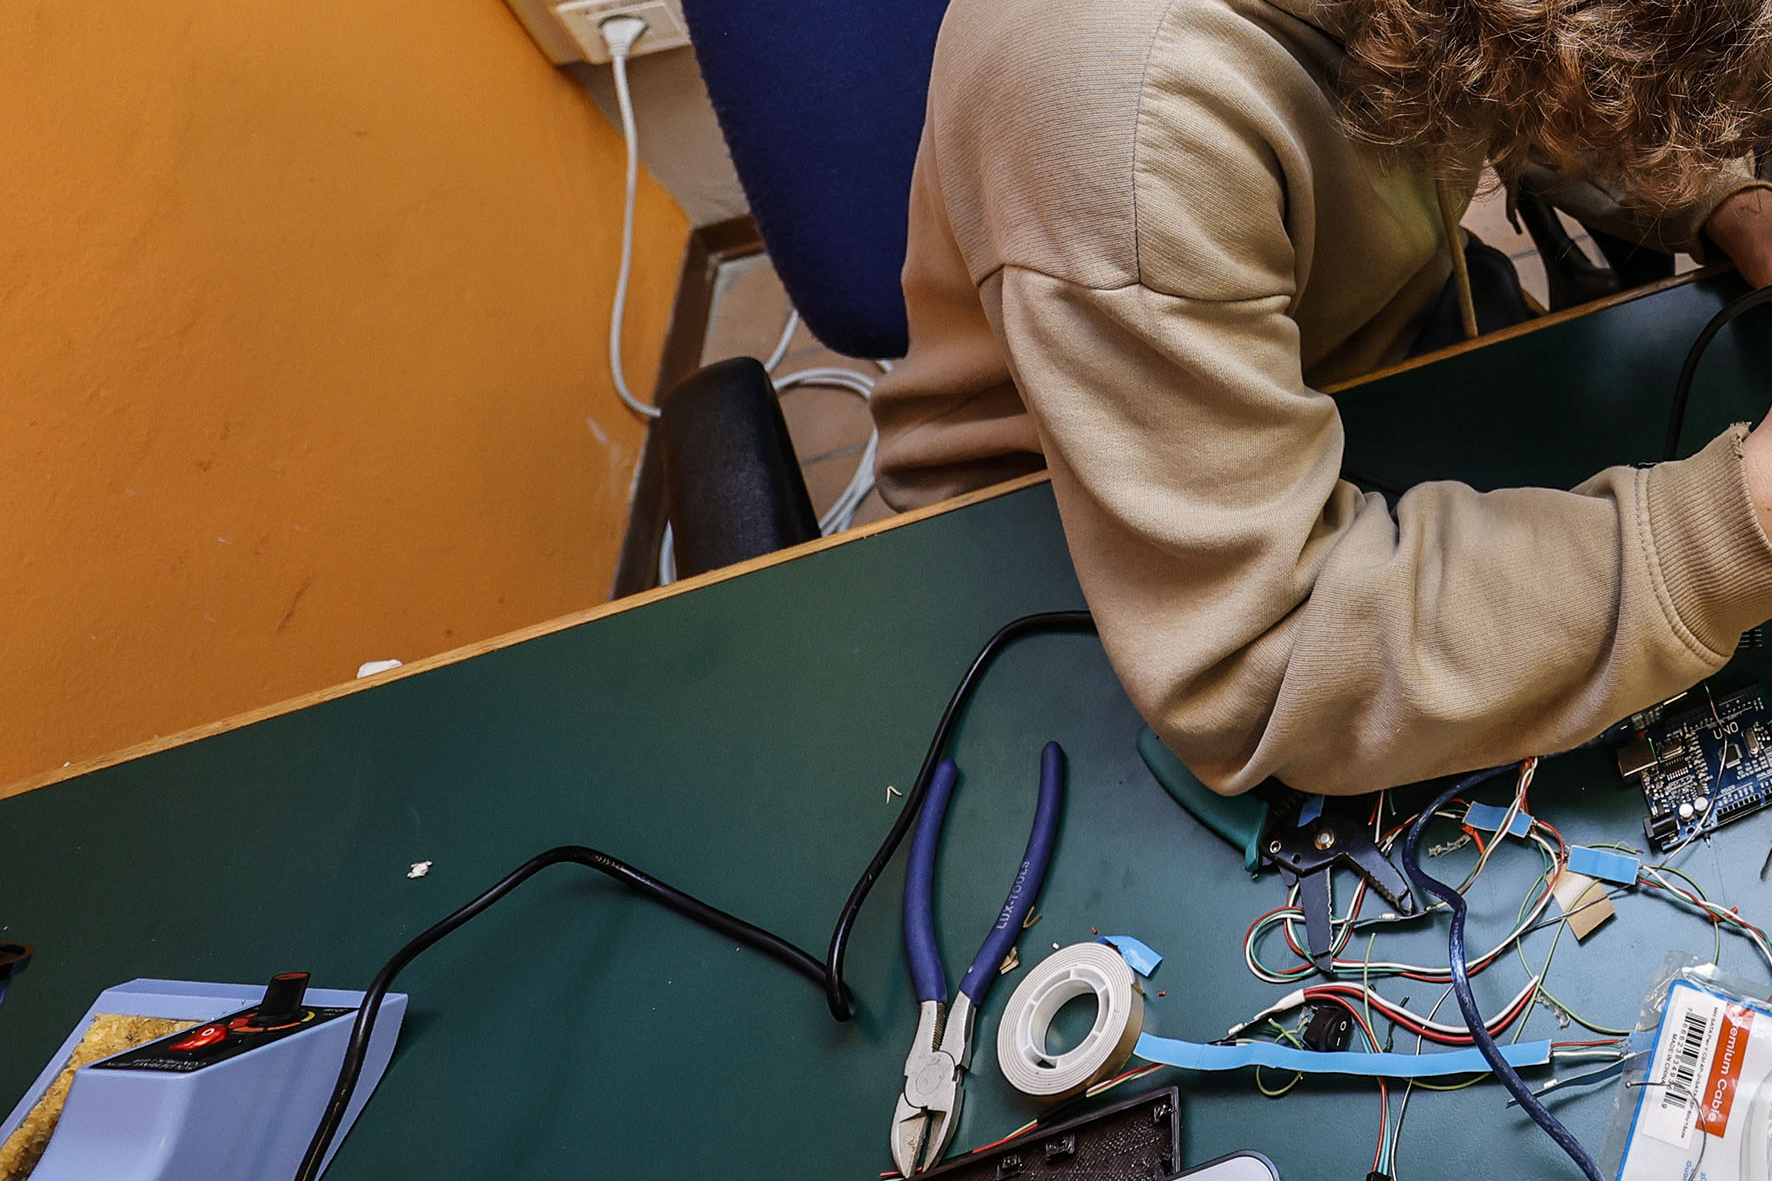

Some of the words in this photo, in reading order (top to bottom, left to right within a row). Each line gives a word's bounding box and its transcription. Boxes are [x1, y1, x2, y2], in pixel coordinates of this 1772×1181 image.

[1713, 721, 1739, 740] UNO
[996, 861, 1031, 929] LUX-TOOLS
[1668, 1033, 1678, 1053] MADE
[1719, 1016, 1744, 1076] Premium
[1661, 1062, 1670, 1084] CHINA
[1707, 1079, 1729, 1123] Cable
